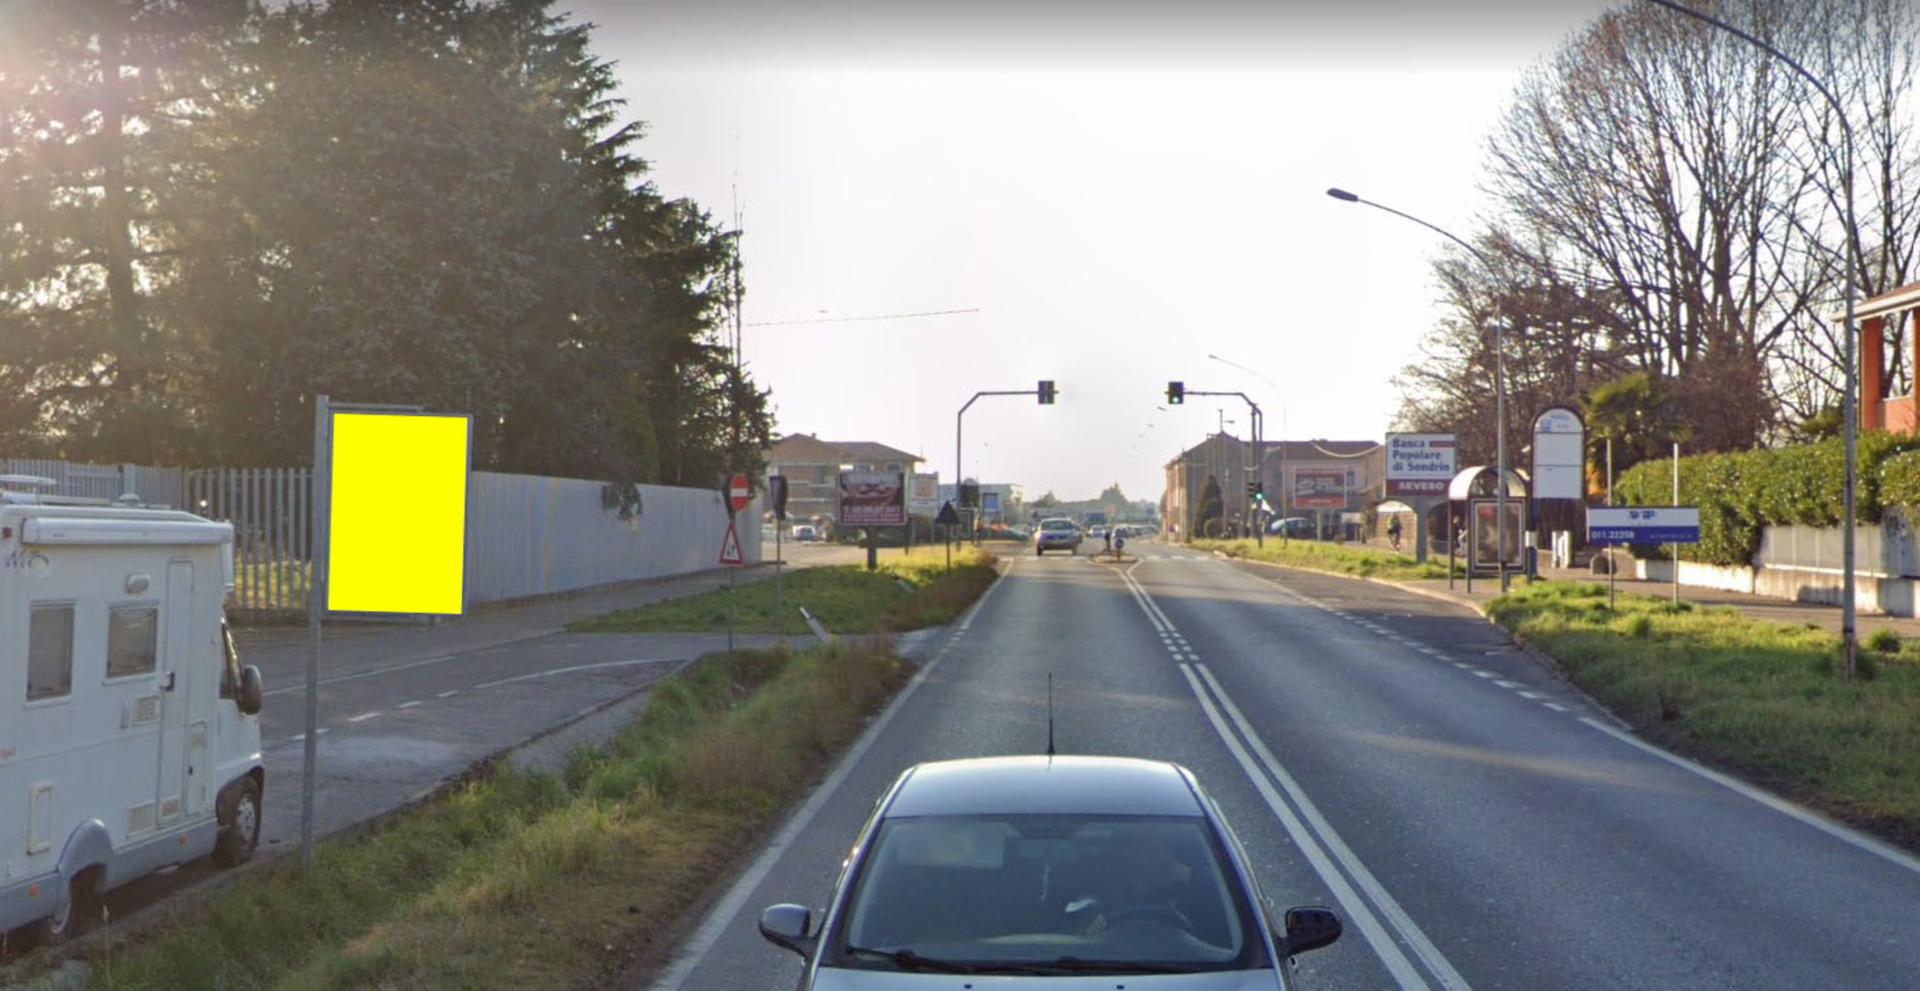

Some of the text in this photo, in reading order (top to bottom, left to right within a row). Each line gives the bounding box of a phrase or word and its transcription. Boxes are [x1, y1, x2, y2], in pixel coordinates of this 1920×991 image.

[1392, 437, 1425, 448] Banca
[1392, 449, 1441, 461] Popolare
[1392, 461, 1450, 471] di Sondrio
[1398, 481, 1444, 490] SEVESO
